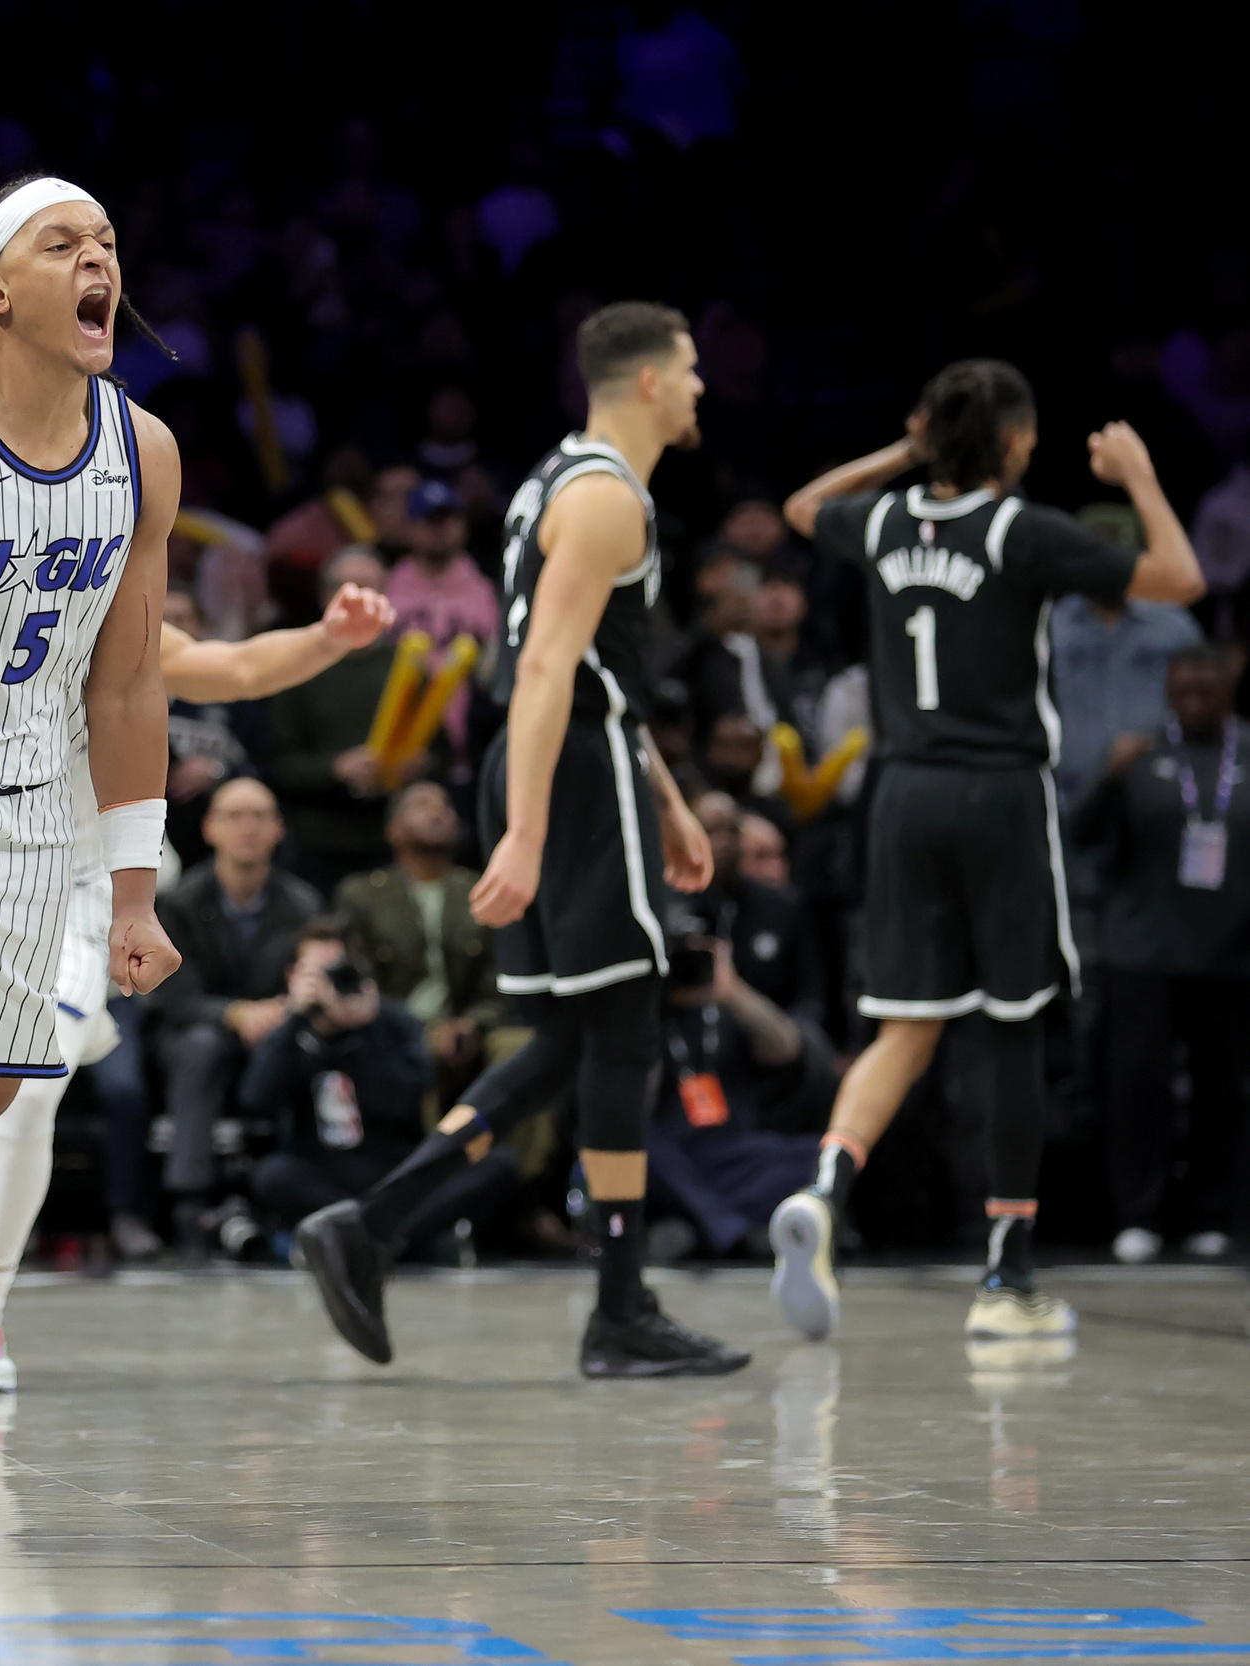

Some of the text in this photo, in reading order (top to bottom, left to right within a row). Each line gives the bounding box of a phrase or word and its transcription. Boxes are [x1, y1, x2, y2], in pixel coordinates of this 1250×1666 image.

[89, 469, 129, 489] Disney
[0, 610, 61, 685] 5
[904, 605, 940, 711] 1
